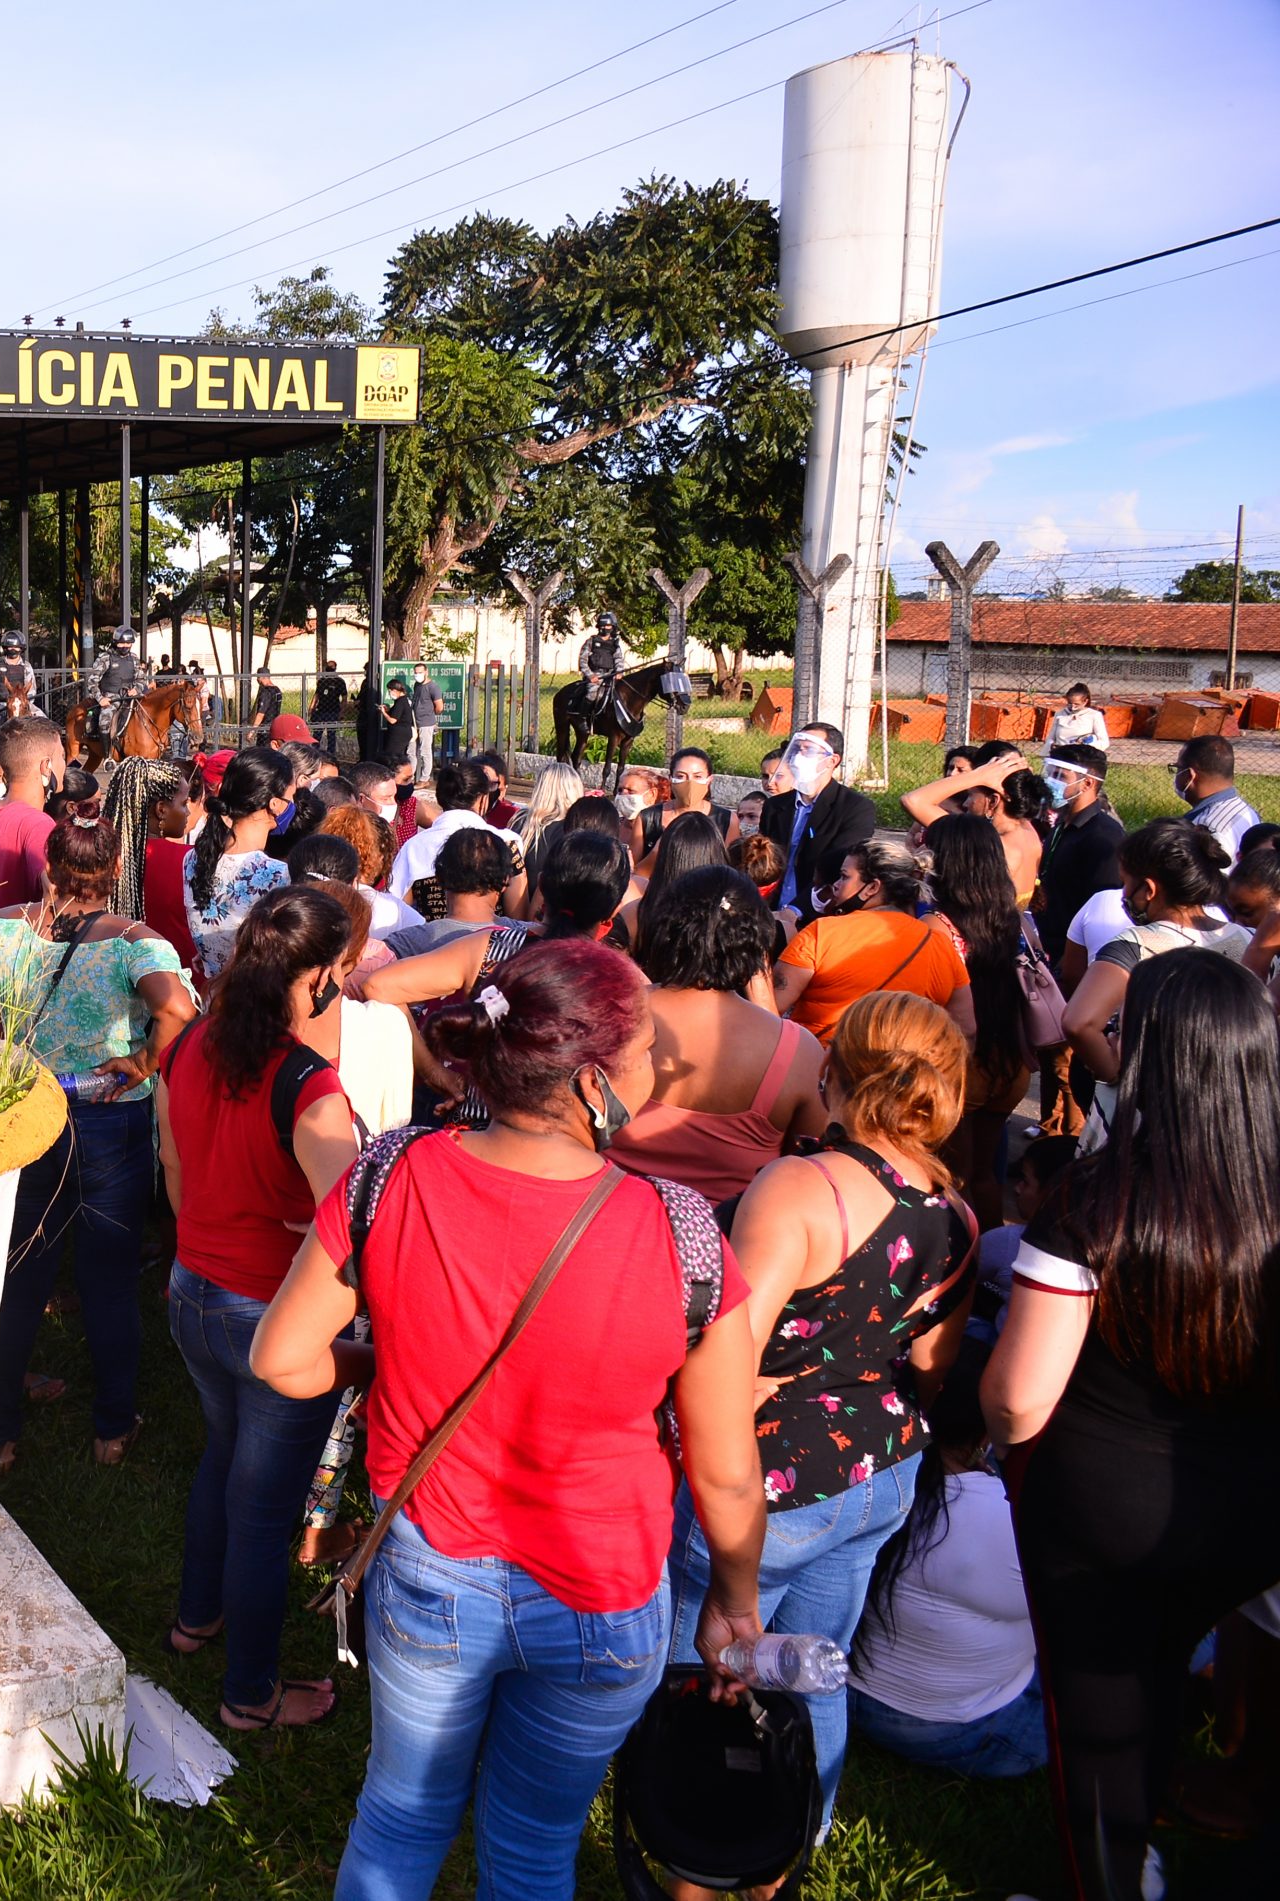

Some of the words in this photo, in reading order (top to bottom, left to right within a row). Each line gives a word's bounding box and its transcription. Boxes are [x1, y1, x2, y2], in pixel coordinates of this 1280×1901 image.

[158, 354, 344, 411] PENAL
[364, 385, 409, 402] DGAP
[440, 668, 462, 676] SISTEMA
[443, 691, 457, 699] PARE
[457, 691, 462, 699] E
[443, 702, 457, 712] EÇÃO
